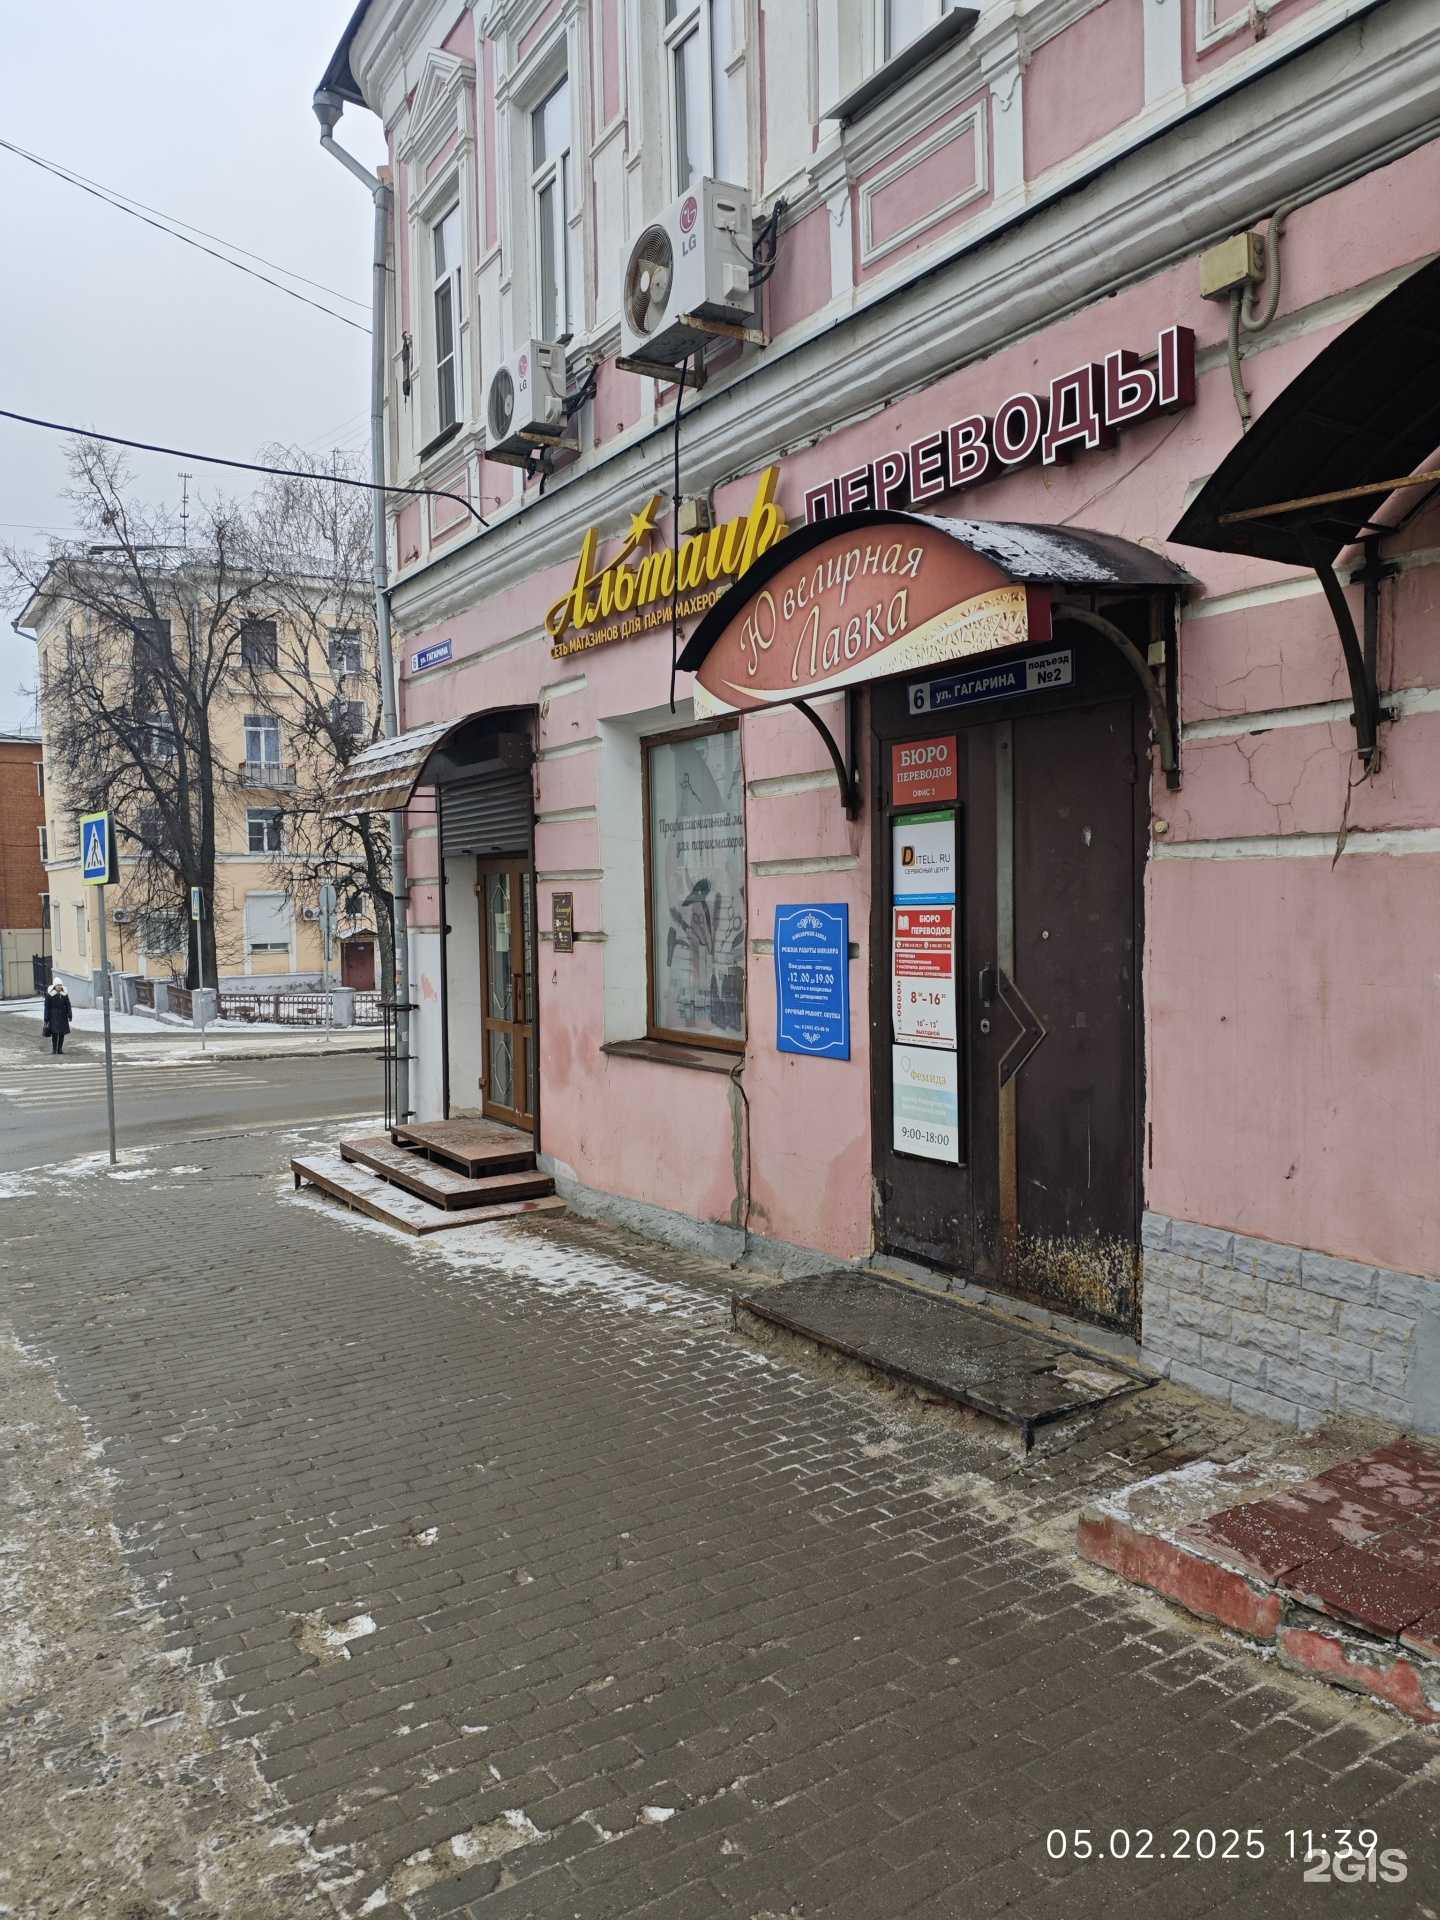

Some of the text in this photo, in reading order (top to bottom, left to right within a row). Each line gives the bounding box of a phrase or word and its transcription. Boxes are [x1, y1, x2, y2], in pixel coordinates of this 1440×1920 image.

[682, 233, 697, 256] LG
[519, 379, 528, 392] LG
[804, 325, 1194, 524] ПЕРЕВОДЫ
[545, 466, 789, 636] Альтаир
[740, 543, 924, 676] Ювелирная
[569, 625, 619, 653] МАГАЗИНОВ
[621, 616, 641, 640] ДЛЯ
[791, 587, 909, 682] Лавка
[1028, 654, 1069, 671] подъезд
[1037, 668, 1062, 685] №2
[913, 672, 1016, 710] 6 ул. ГАГАРИНА
[901, 744, 948, 767] БЮРО
[897, 766, 953, 783] ПЕРЕВОДОВ
[919, 914, 941, 923] БЮРО
[911, 926, 951, 937] ПЕРЕВОДОВ
[901, 1126, 950, 1146] 9:00-18:00
